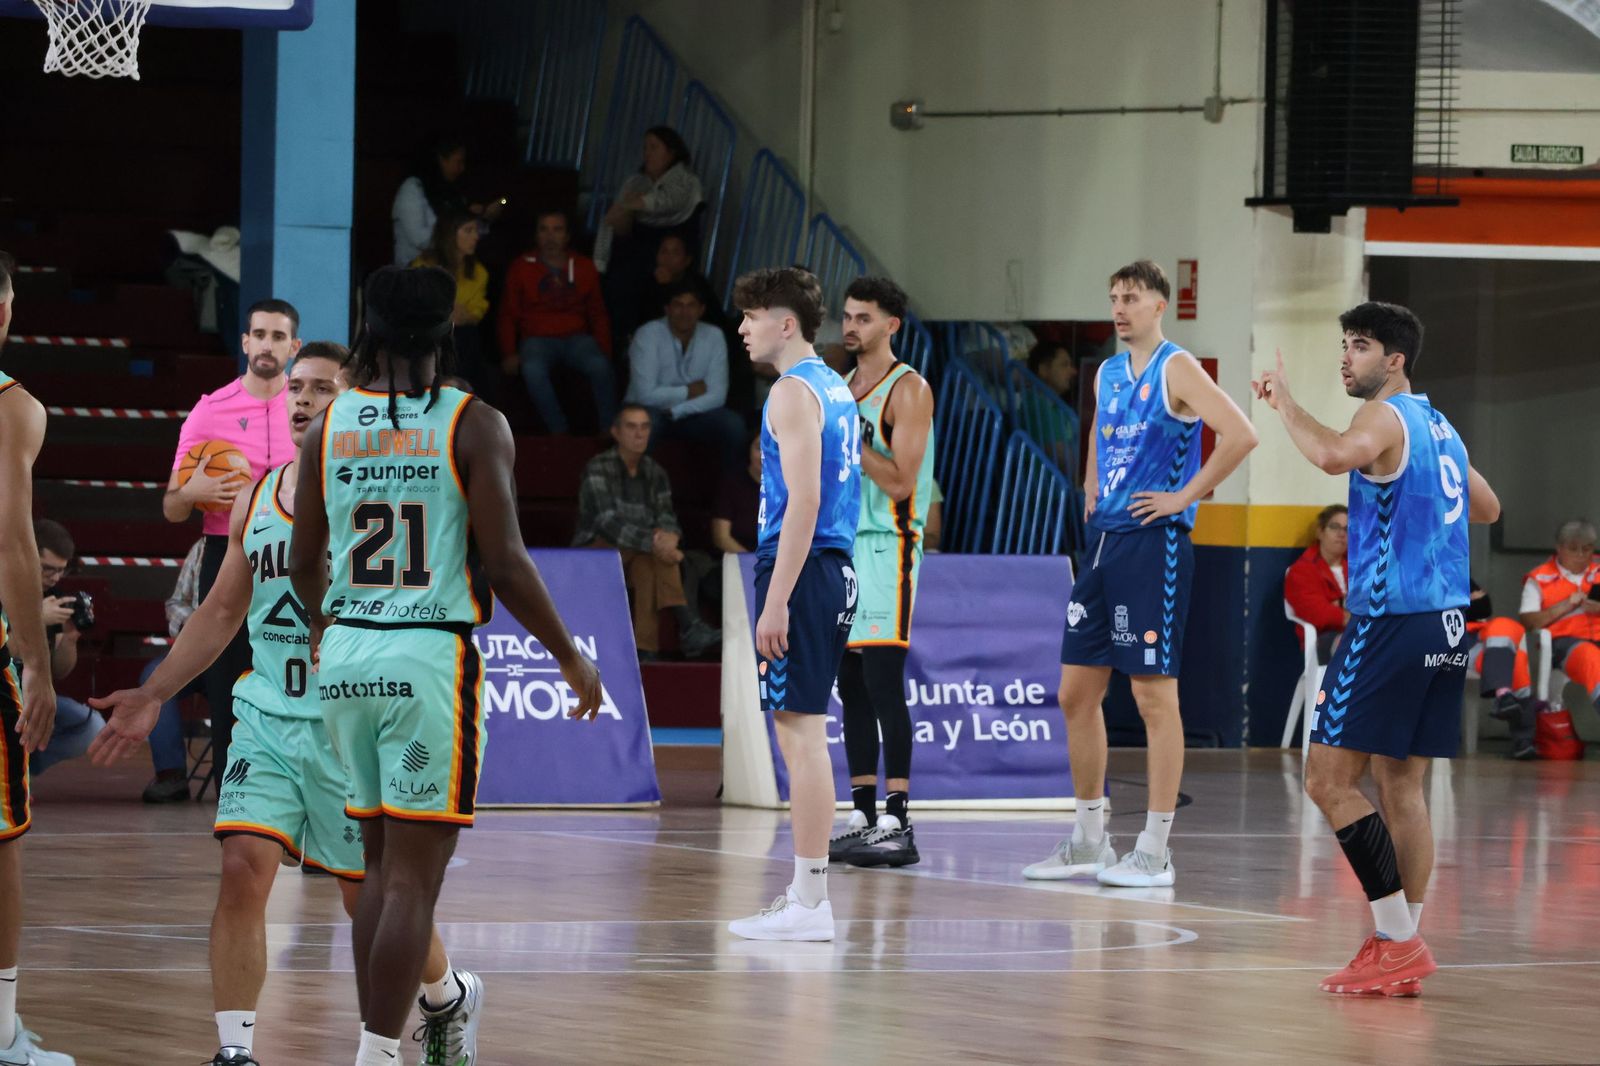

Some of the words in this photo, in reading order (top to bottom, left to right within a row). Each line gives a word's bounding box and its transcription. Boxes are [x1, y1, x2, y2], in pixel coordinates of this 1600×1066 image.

[332, 429, 440, 459] HOLLOWELL
[356, 485, 388, 494] TRAVEL
[390, 485, 441, 493] ECNOLOGY
[1439, 454, 1464, 525] 9
[350, 502, 432, 588] 21
[249, 541, 290, 583] PAL
[349, 600, 385, 616] THB
[385, 601, 448, 620] hotels
[263, 631, 310, 645] conectab
[284, 658, 306, 698] 0
[319, 676, 414, 700] motorisa
[905, 679, 995, 706] Junta
[1004, 678, 1046, 705] de
[484, 680, 623, 720] MORA
[942, 719, 963, 750] y
[973, 713, 1051, 742] León
[389, 777, 440, 795] ALUA
